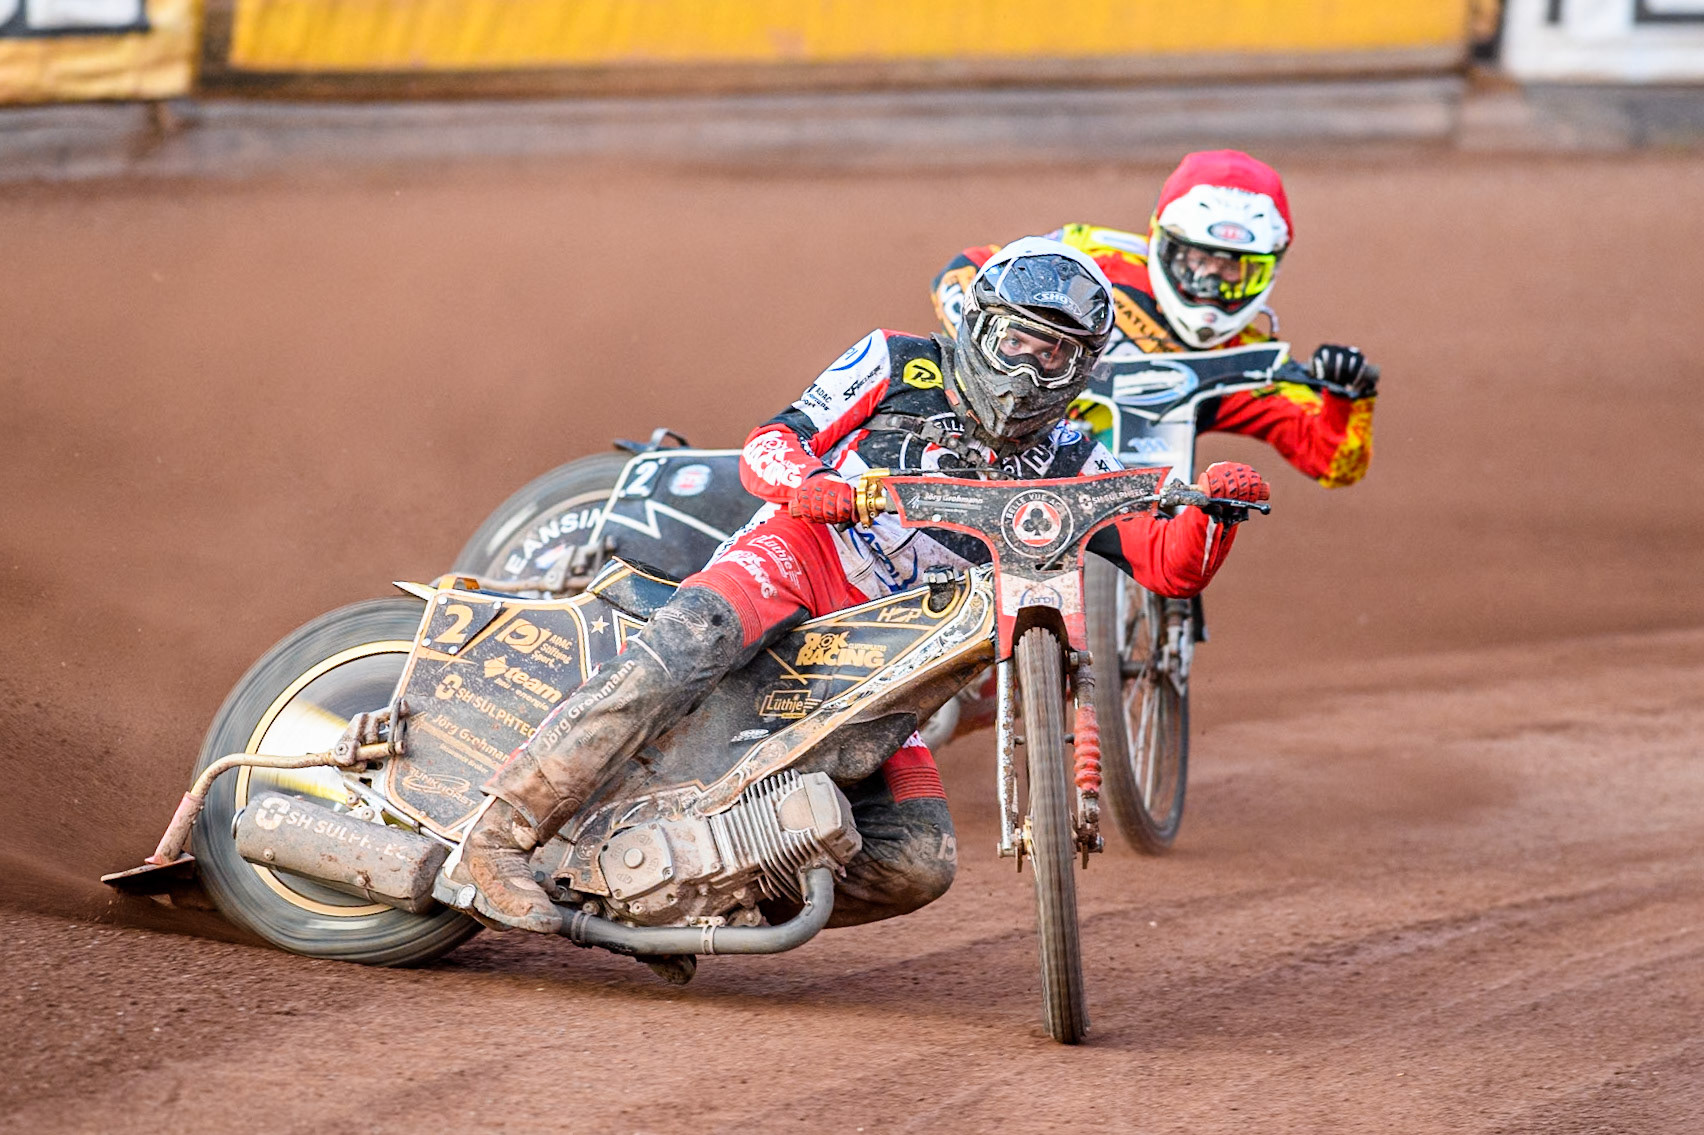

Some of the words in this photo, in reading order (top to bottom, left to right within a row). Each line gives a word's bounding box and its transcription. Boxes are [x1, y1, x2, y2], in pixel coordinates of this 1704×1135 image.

[626, 460, 660, 495] 2
[1005, 496, 1027, 519] BELLE
[1028, 493, 1048, 502] VUE
[434, 604, 474, 644] 2
[549, 634, 573, 650] ADAC
[795, 647, 885, 668] RACING
[503, 667, 563, 704] team
[542, 717, 573, 753] Jörg
[567, 659, 637, 720] Grohmann
[765, 694, 804, 714] Lüthje
[432, 714, 460, 736] Jörg
[459, 728, 511, 764] Grohman
[285, 810, 314, 830] SH
